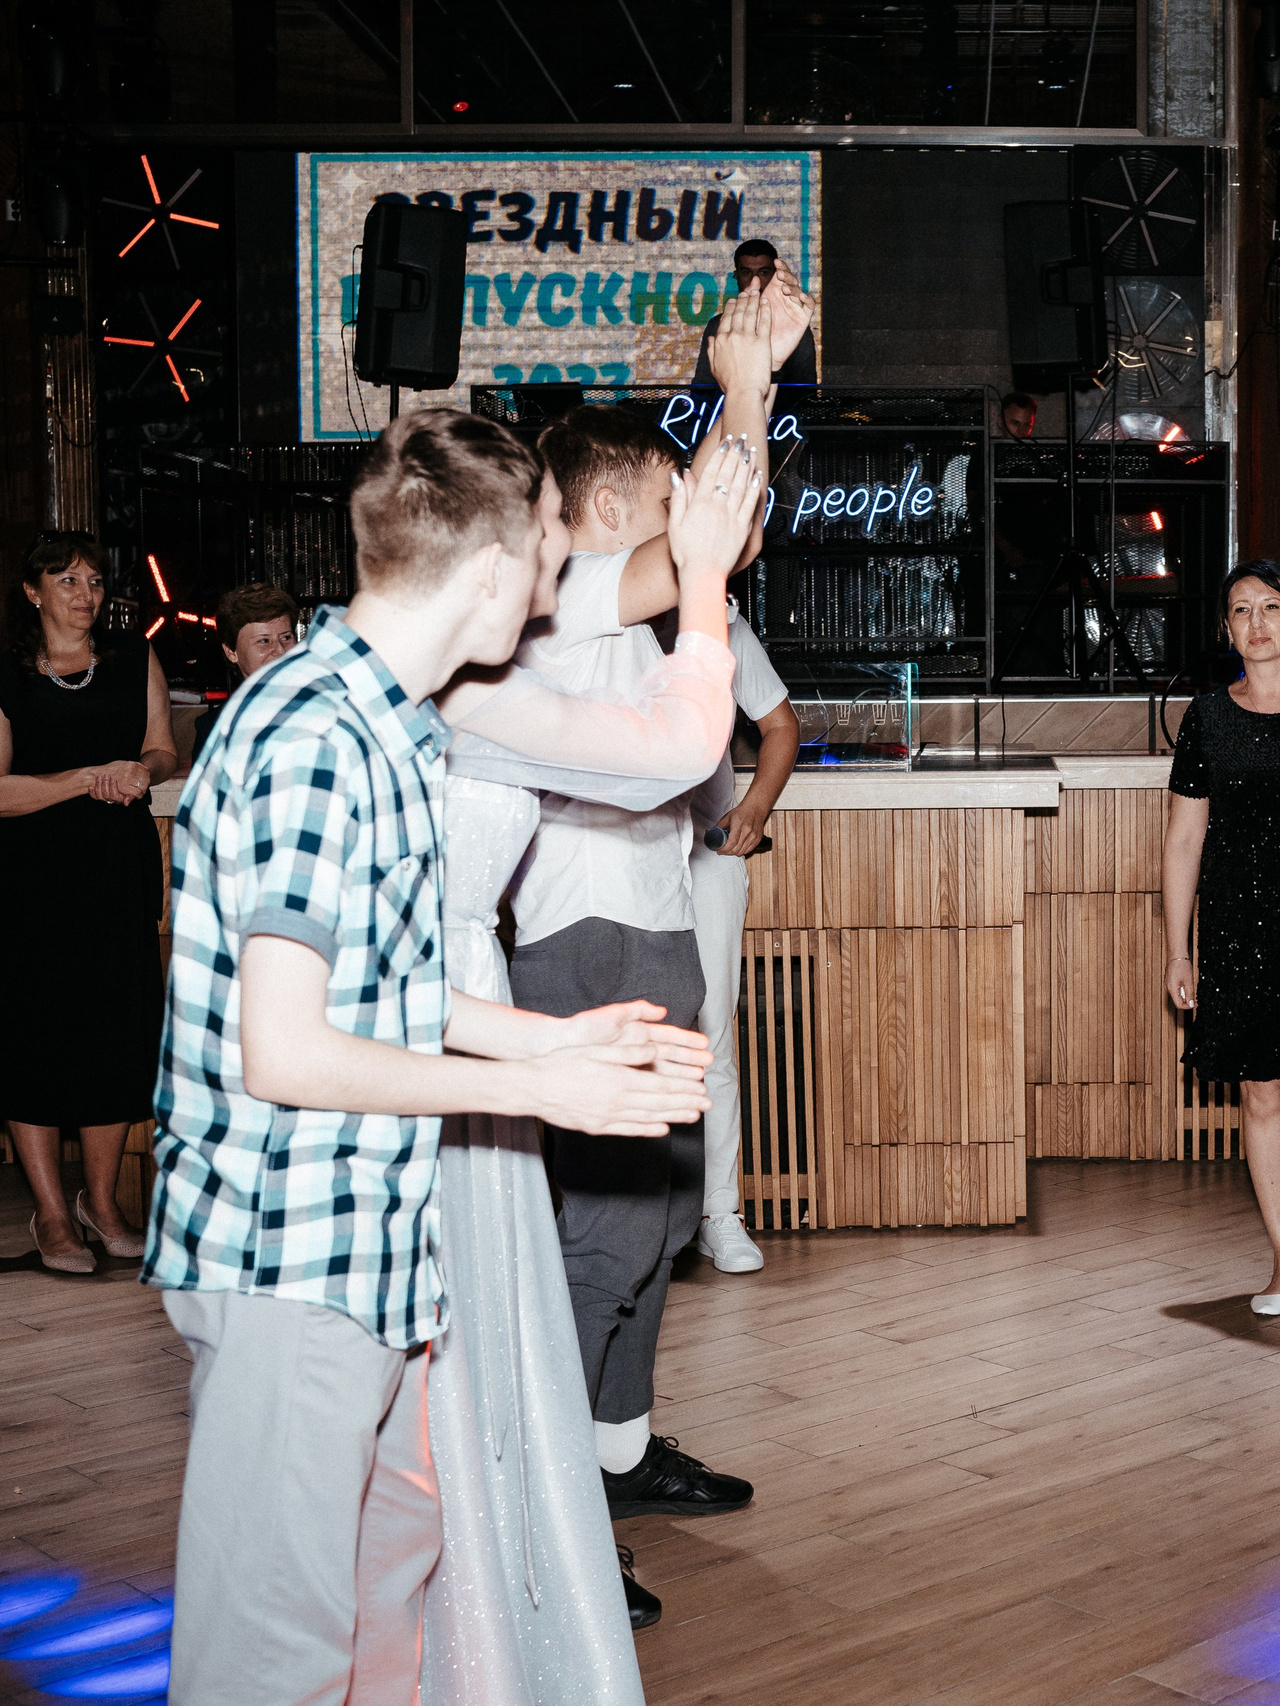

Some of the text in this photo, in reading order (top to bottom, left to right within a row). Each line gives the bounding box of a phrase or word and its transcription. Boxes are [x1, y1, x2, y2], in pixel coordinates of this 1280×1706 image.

[374, 170, 744, 254] ЕЗДНЫЙ
[341, 269, 742, 328] ПУСКНО
[792, 465, 934, 534] people
